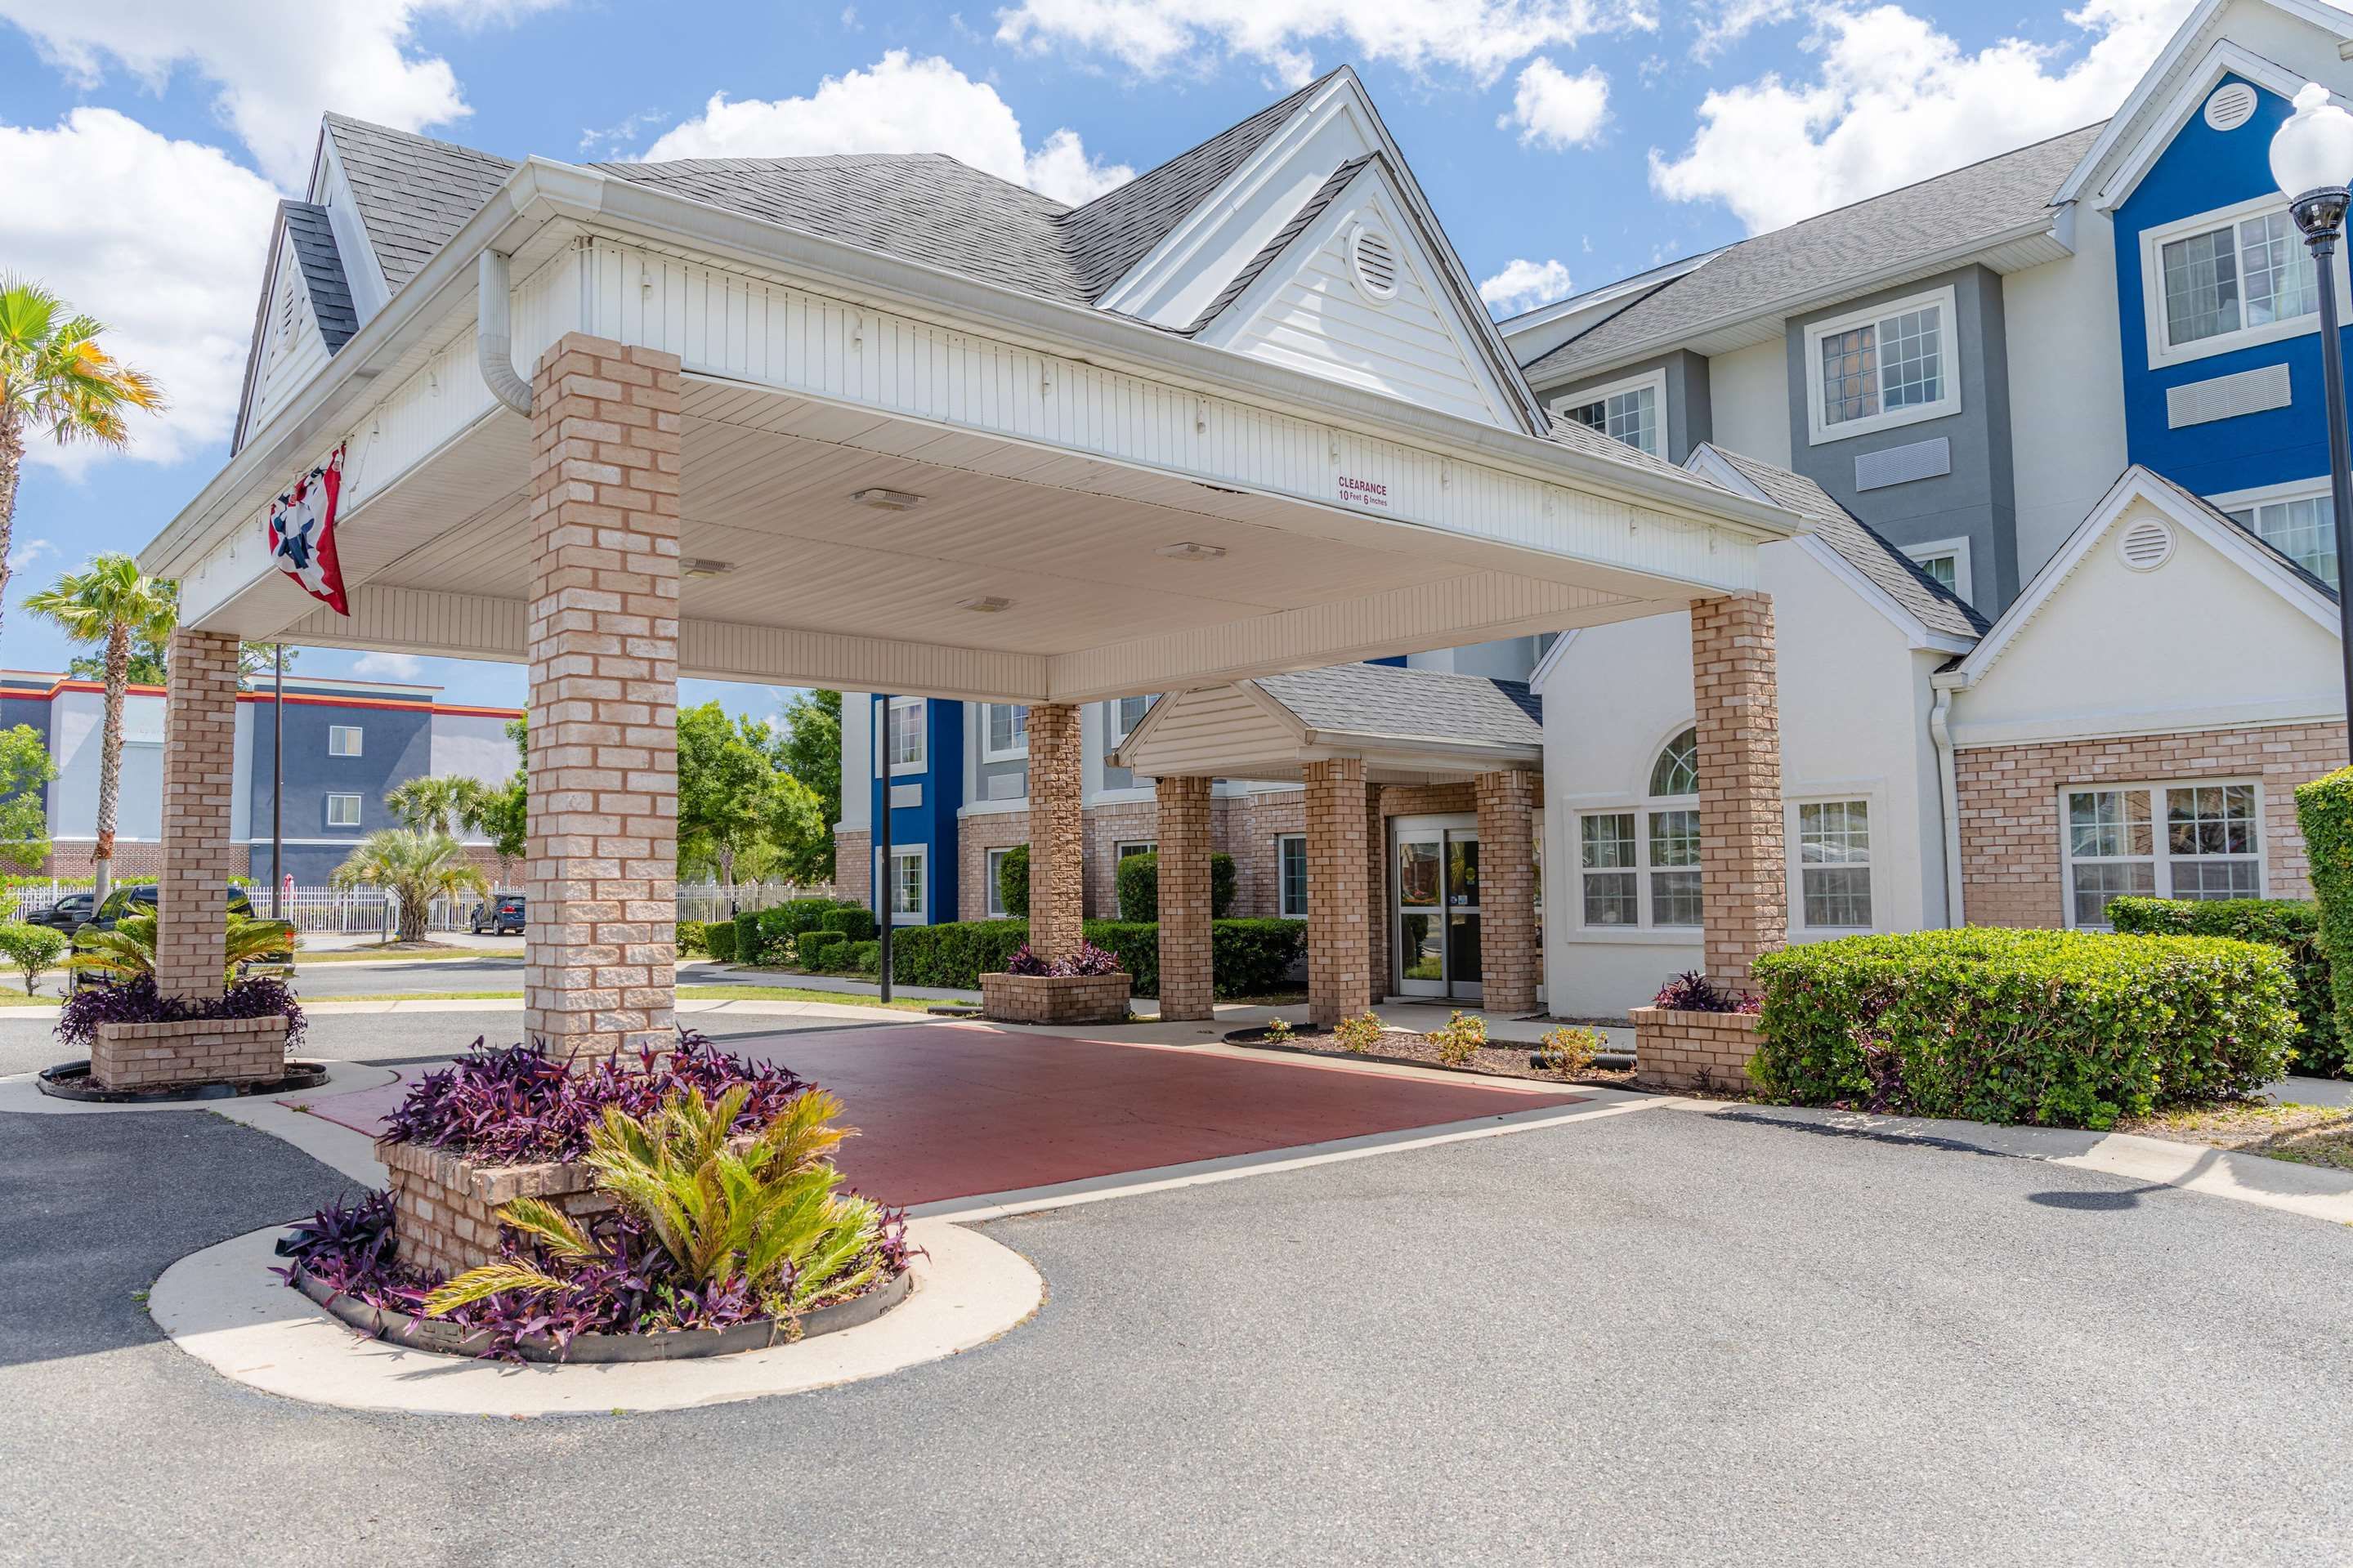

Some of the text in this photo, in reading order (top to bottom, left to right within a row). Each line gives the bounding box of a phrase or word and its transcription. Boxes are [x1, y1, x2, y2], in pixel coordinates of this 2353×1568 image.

[1339, 476, 1386, 496] CLEARANCE
[1340, 490, 1387, 507] 10 Feet 6 Inches
